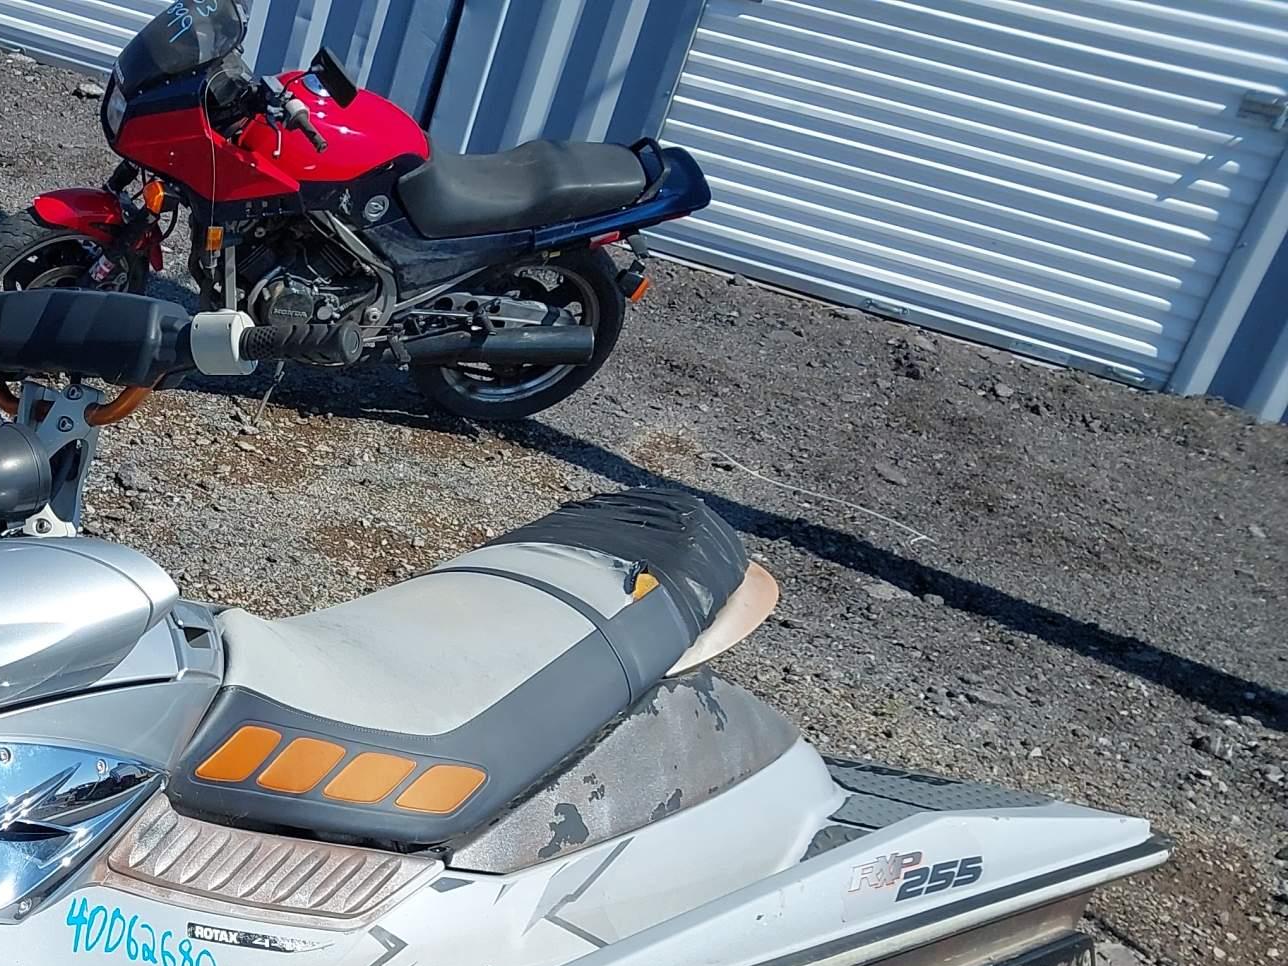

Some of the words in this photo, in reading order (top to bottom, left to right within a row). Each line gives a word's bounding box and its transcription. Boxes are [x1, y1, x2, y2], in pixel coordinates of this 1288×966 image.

[273, 307, 308, 318] HONDA
[848, 850, 923, 893] RXP
[895, 855, 984, 903] 255
[194, 925, 241, 945] ROTAX
